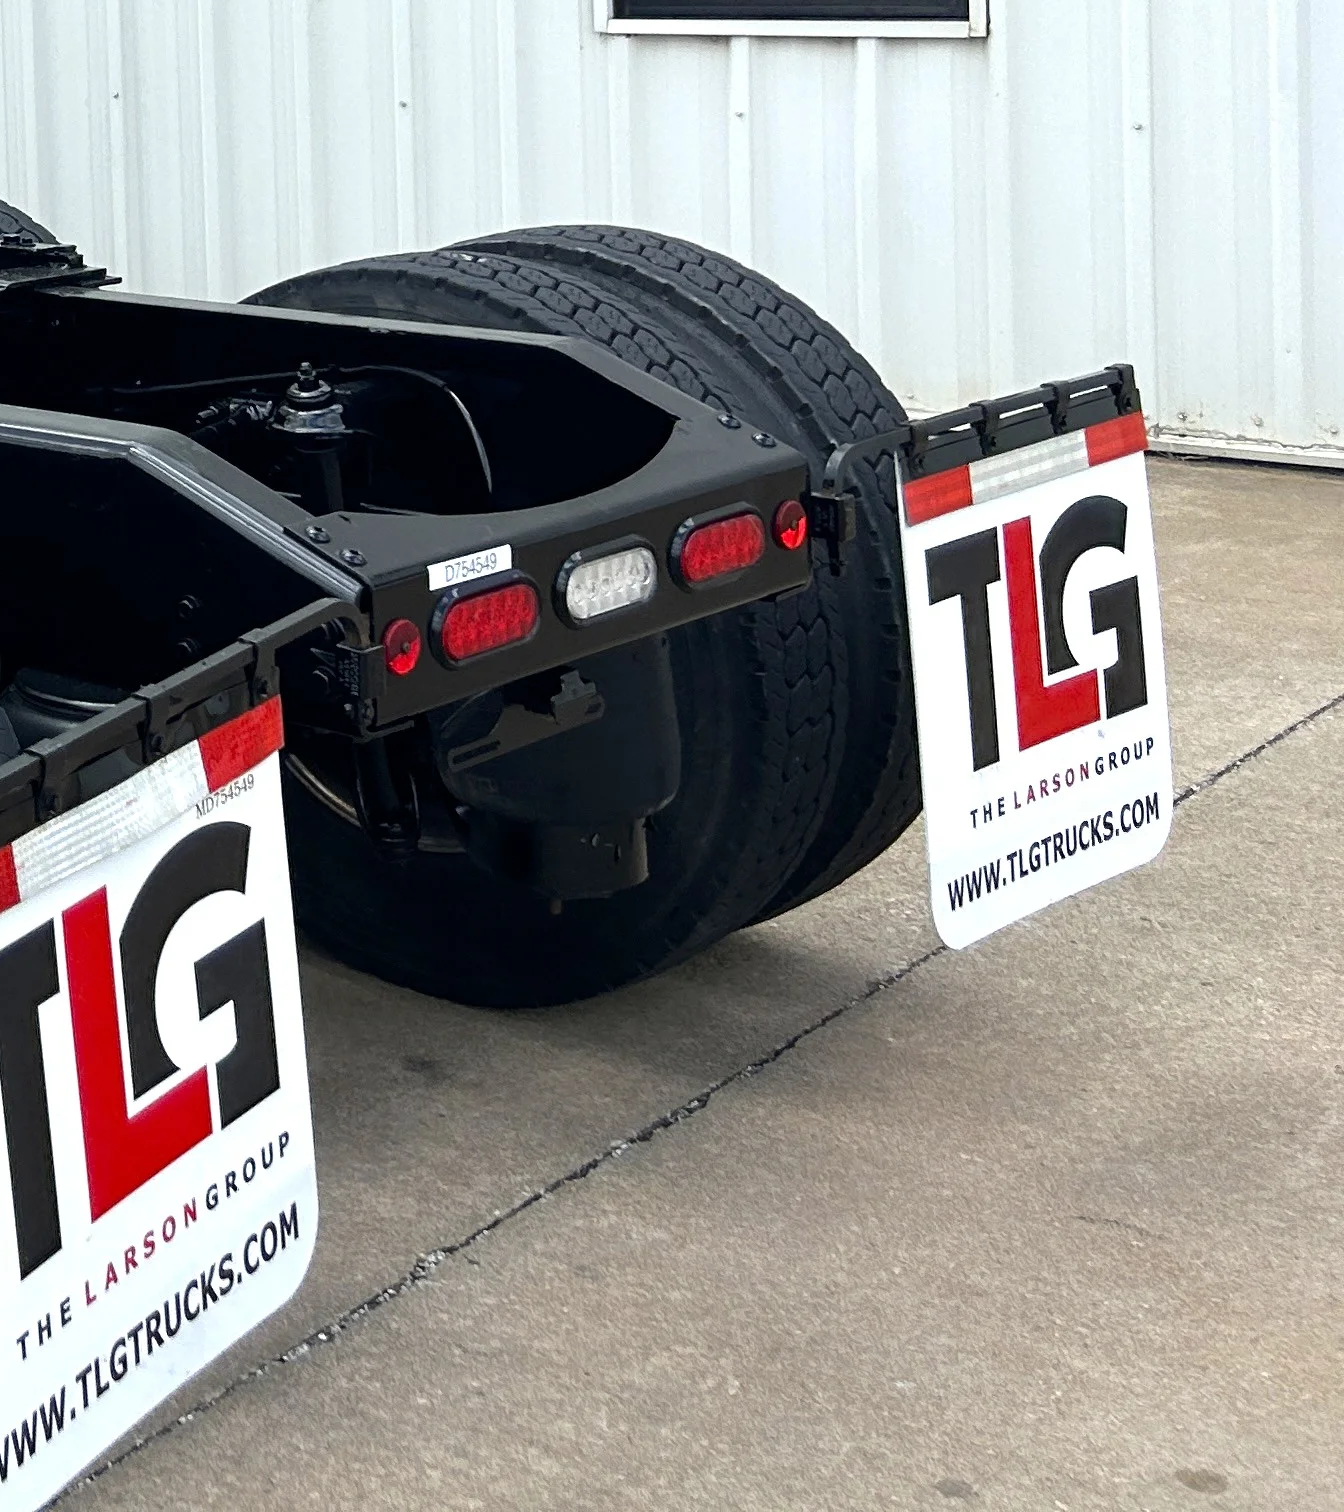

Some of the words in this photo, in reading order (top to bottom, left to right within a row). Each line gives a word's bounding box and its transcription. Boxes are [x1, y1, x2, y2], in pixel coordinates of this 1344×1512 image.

[444, 552, 497, 583] D754549
[924, 494, 1149, 772] TLG
[970, 797, 1007, 829] THE
[947, 791, 1161, 912] WWW.TLGTRUCKS.COM
[16, 1299, 75, 1361] THE
